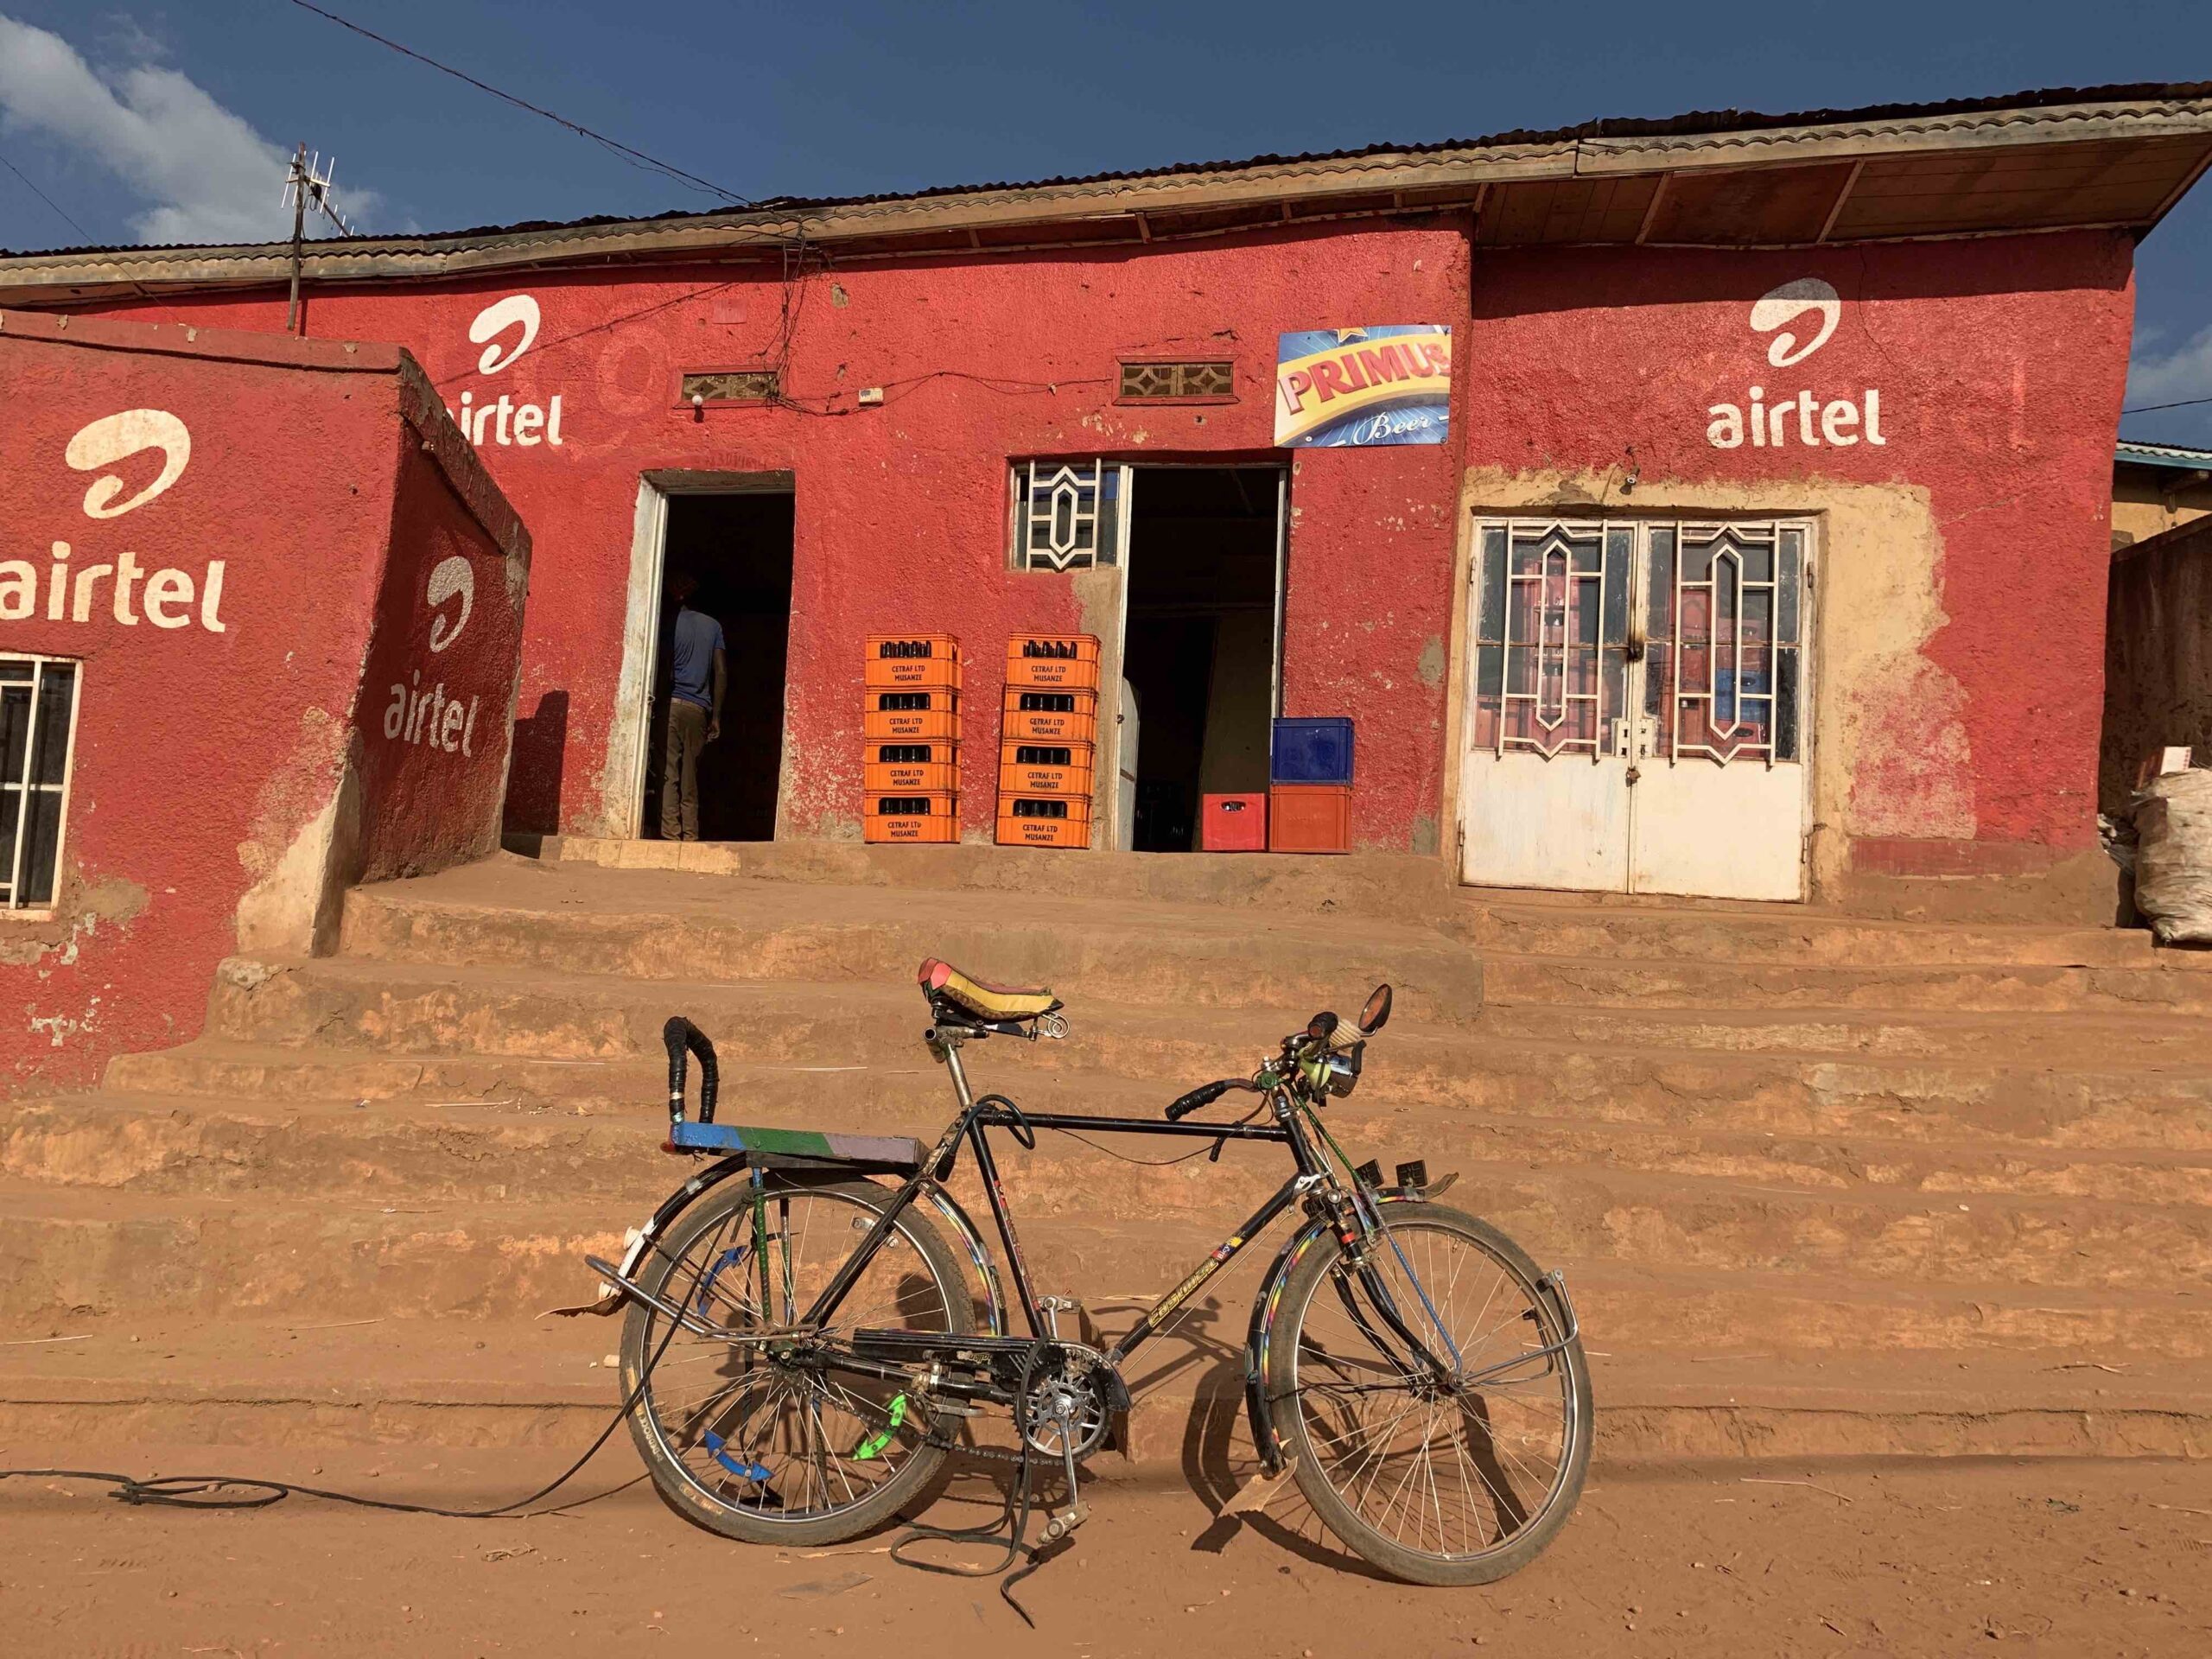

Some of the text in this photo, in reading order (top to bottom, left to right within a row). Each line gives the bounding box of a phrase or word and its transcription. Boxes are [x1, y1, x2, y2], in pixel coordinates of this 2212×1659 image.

[1278, 342, 1451, 416] PRIMUS
[446, 391, 563, 446] irtel
[1353, 411, 1432, 445] Beer
[1707, 386, 1886, 449] airtel
[0, 541, 226, 633] airtel
[384, 669, 480, 758] airtel
